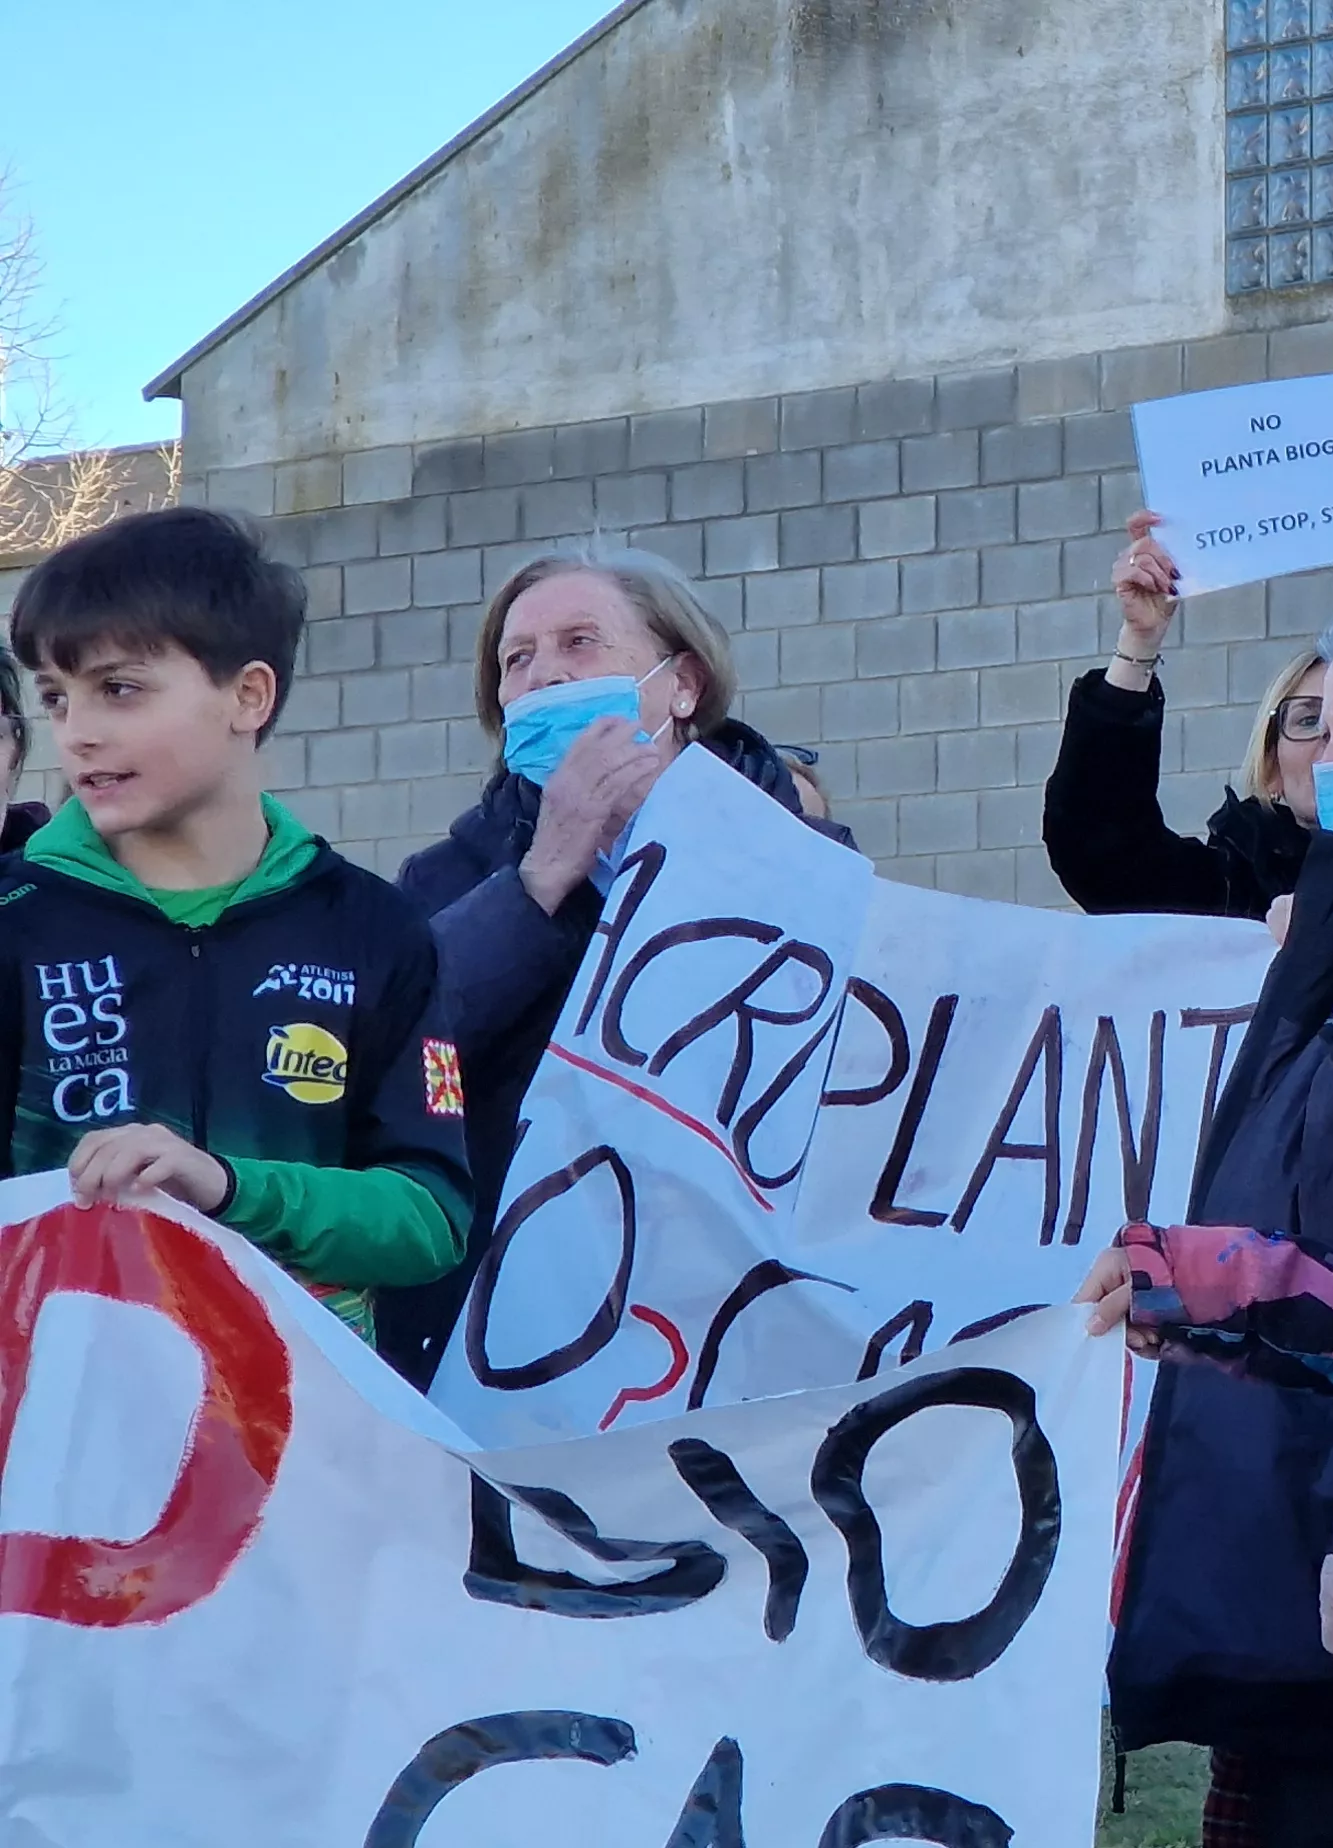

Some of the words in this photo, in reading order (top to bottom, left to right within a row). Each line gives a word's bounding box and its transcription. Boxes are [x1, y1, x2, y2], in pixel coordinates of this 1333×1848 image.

[1250, 413, 1282, 434] NO
[1200, 447, 1281, 478] PLANTA
[1195, 524, 1253, 550] STOP,
[1258, 511, 1317, 538] STOP,
[34, 954, 124, 1001] Hu
[43, 993, 128, 1053] es
[53, 1067, 136, 1123] ca
